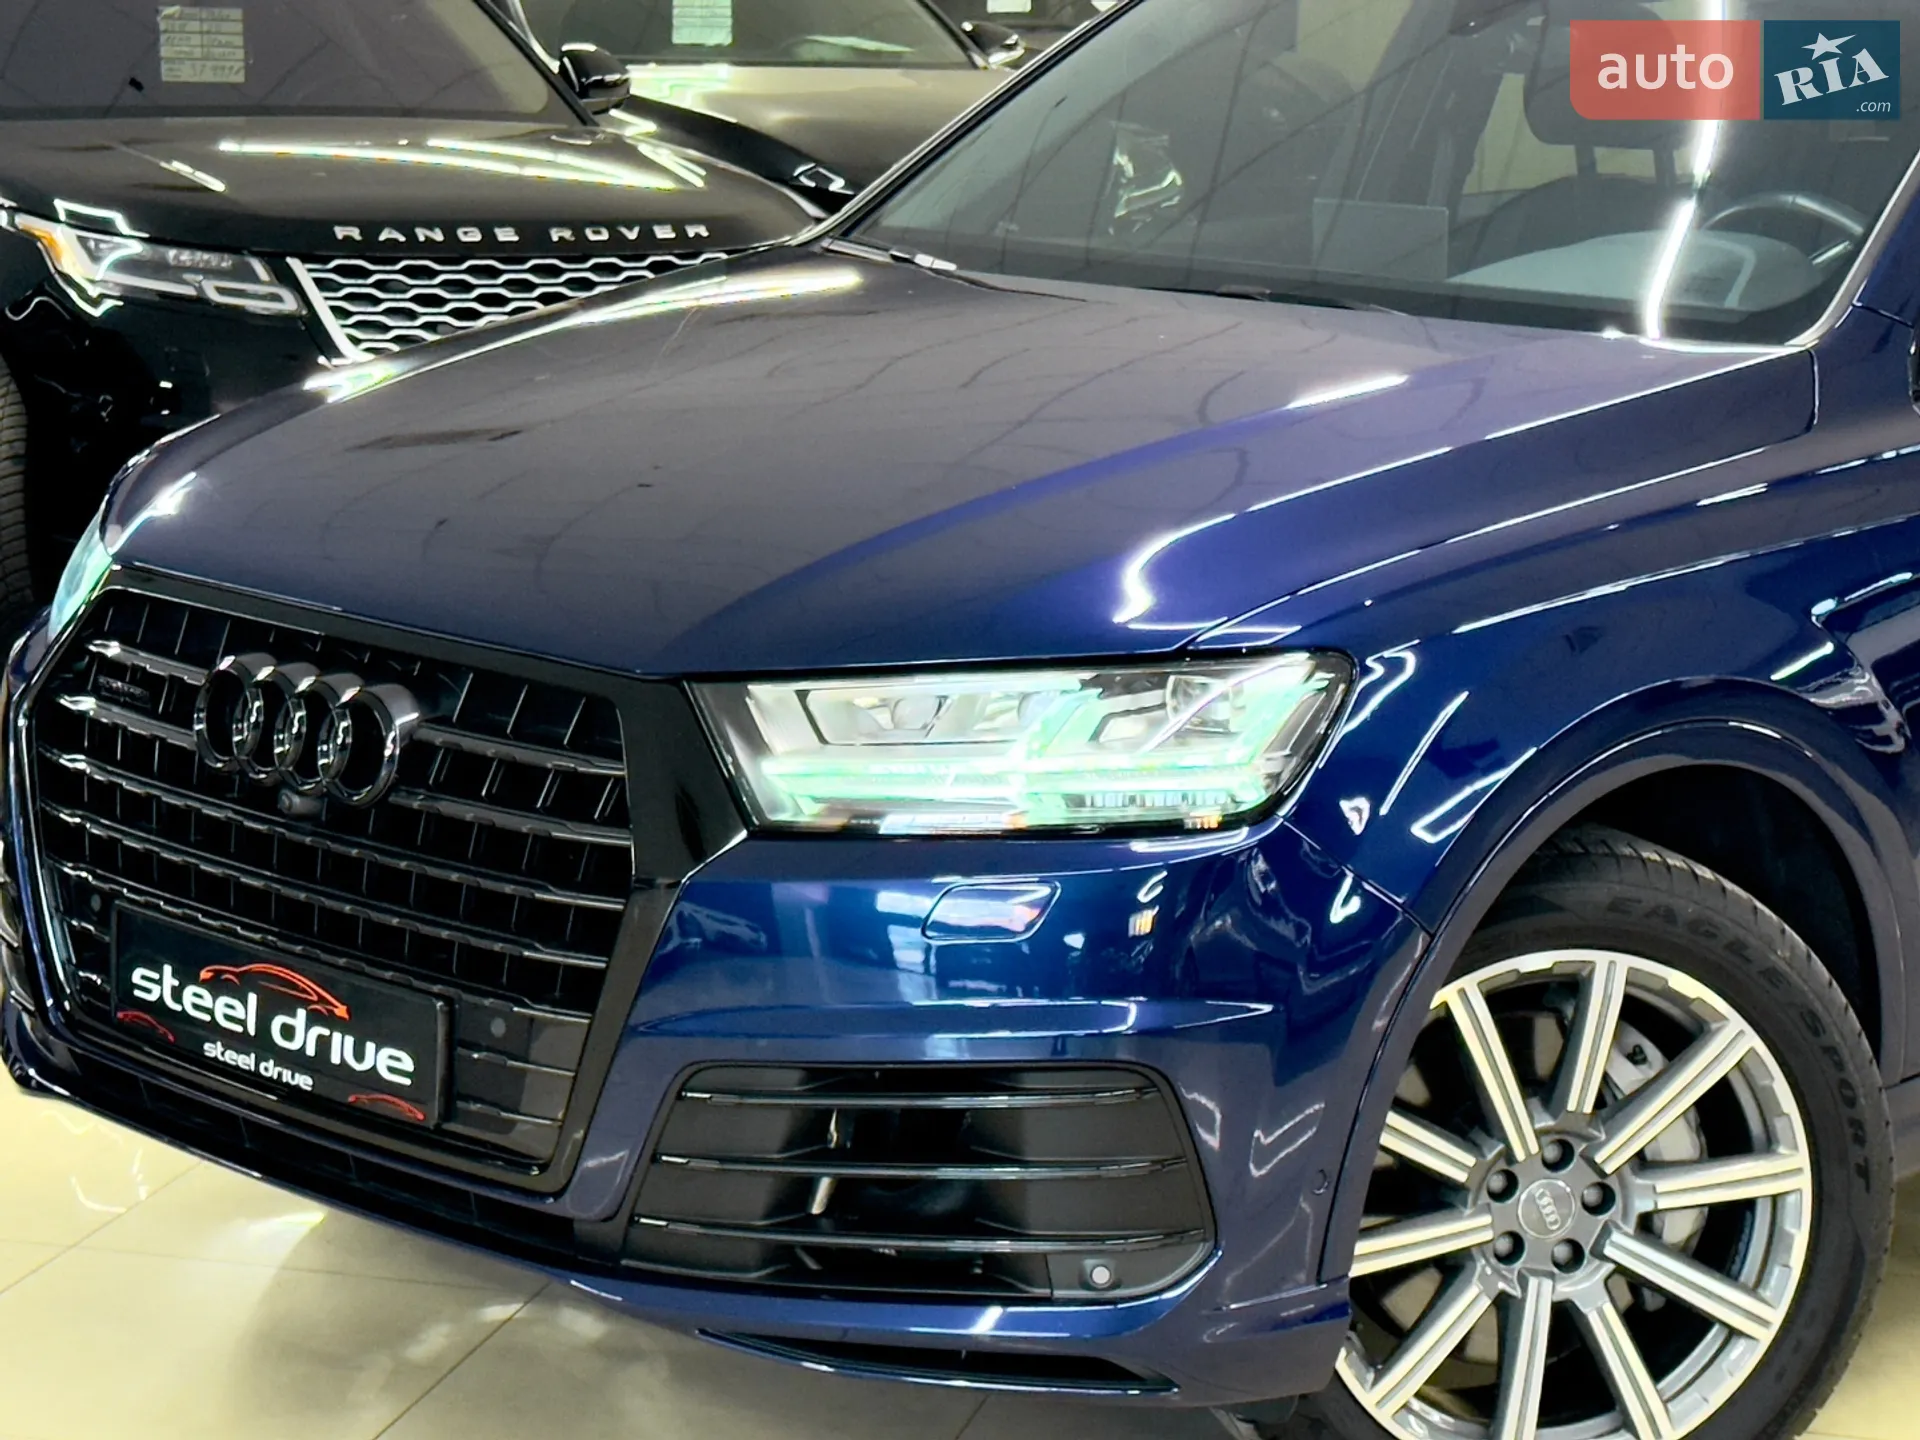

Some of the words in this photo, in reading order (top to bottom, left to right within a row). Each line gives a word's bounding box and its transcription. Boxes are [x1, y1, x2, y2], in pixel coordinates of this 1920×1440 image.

[333, 225, 520, 243] RANGE
[549, 224, 710, 242] ROVER
[131, 963, 258, 1037] steel
[270, 1008, 415, 1087] drive
[202, 1040, 256, 1073] steel
[259, 1059, 314, 1091] drive
